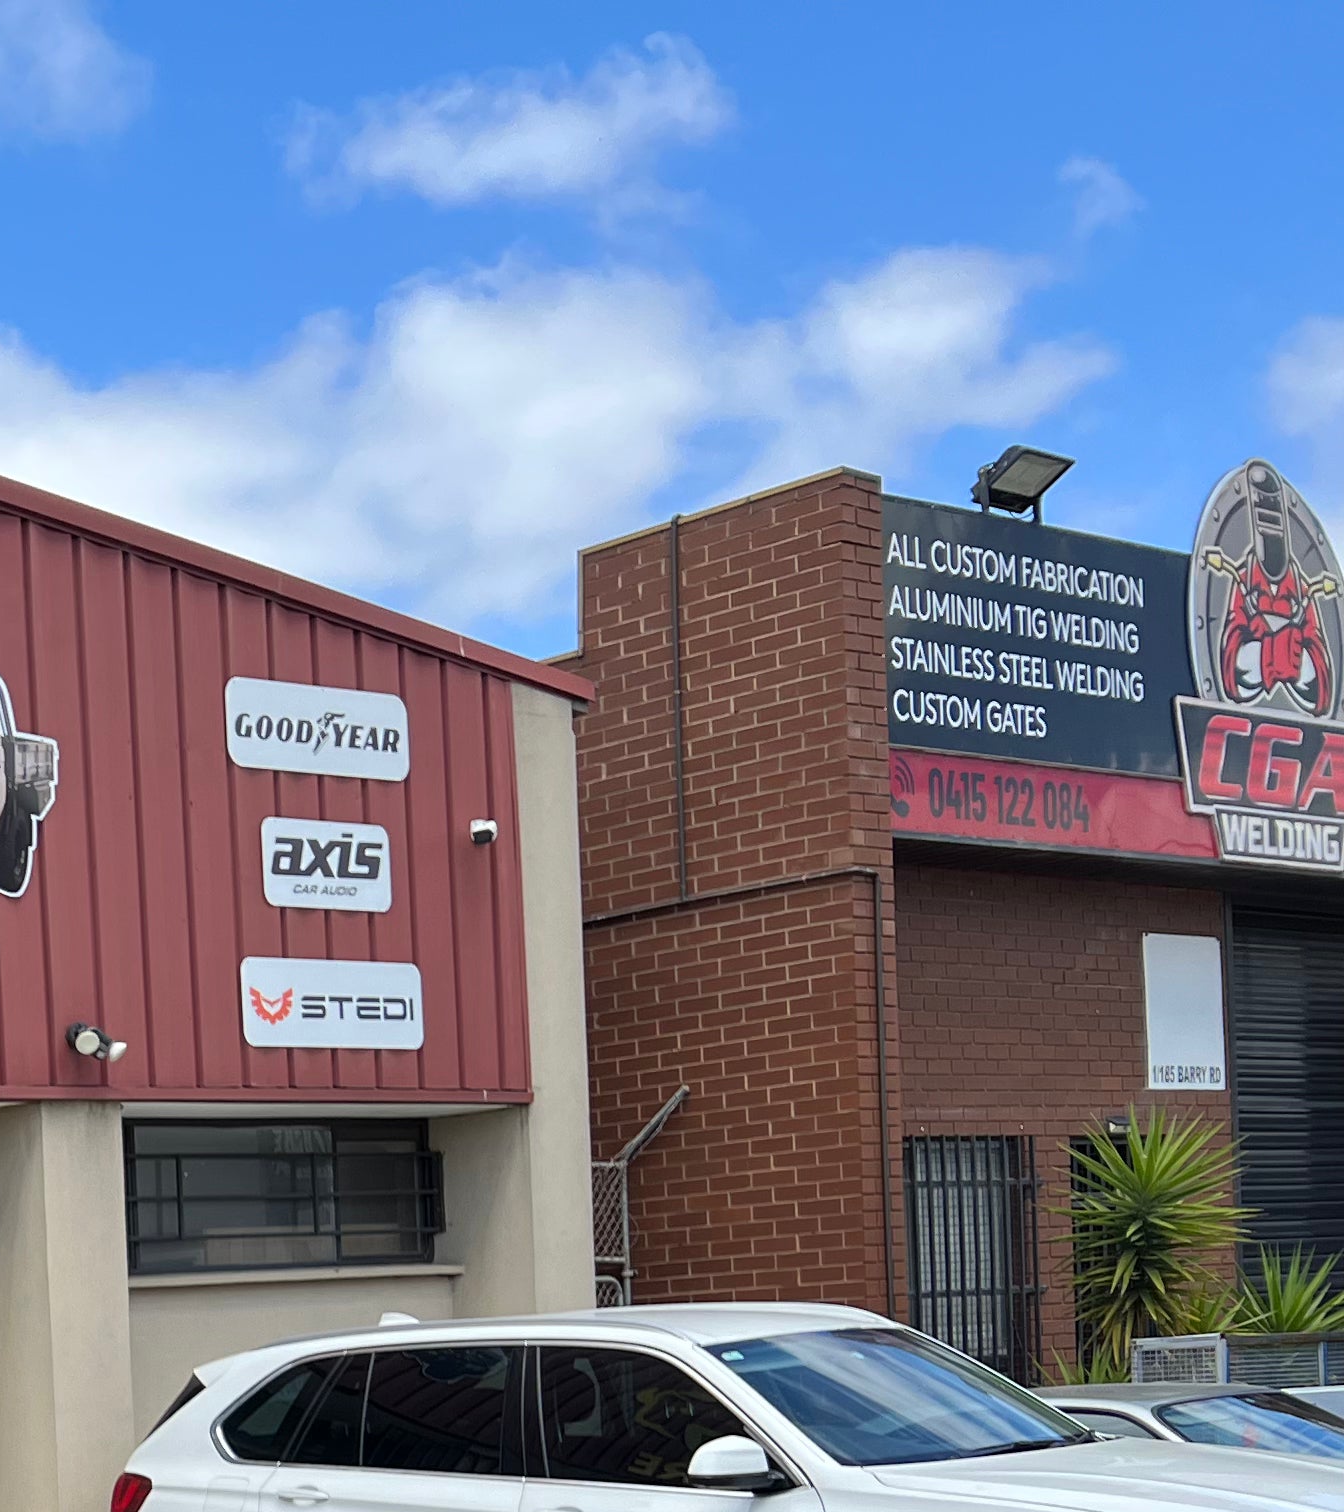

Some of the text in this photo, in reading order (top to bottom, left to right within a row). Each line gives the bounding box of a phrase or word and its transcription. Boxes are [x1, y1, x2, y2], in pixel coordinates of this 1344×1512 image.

[887, 532, 1144, 608] ALL CUSTOM FABRICATION
[889, 585, 1140, 655] ALUMINIUM TIG WELDING
[890, 636, 1144, 702] STAINLESS STEEL WELDING
[892, 688, 1047, 738] CUSTOM GATES
[1198, 714, 1344, 815] CGA
[928, 767, 1090, 833] 0415 122 084
[271, 833, 383, 880] axis
[1221, 813, 1341, 863] WELDING
[292, 884, 358, 897] CAR AUDIO
[301, 994, 414, 1021] STEDI
[1177, 1065, 1207, 1083] BARRY
[1209, 1066, 1222, 1084] RD
